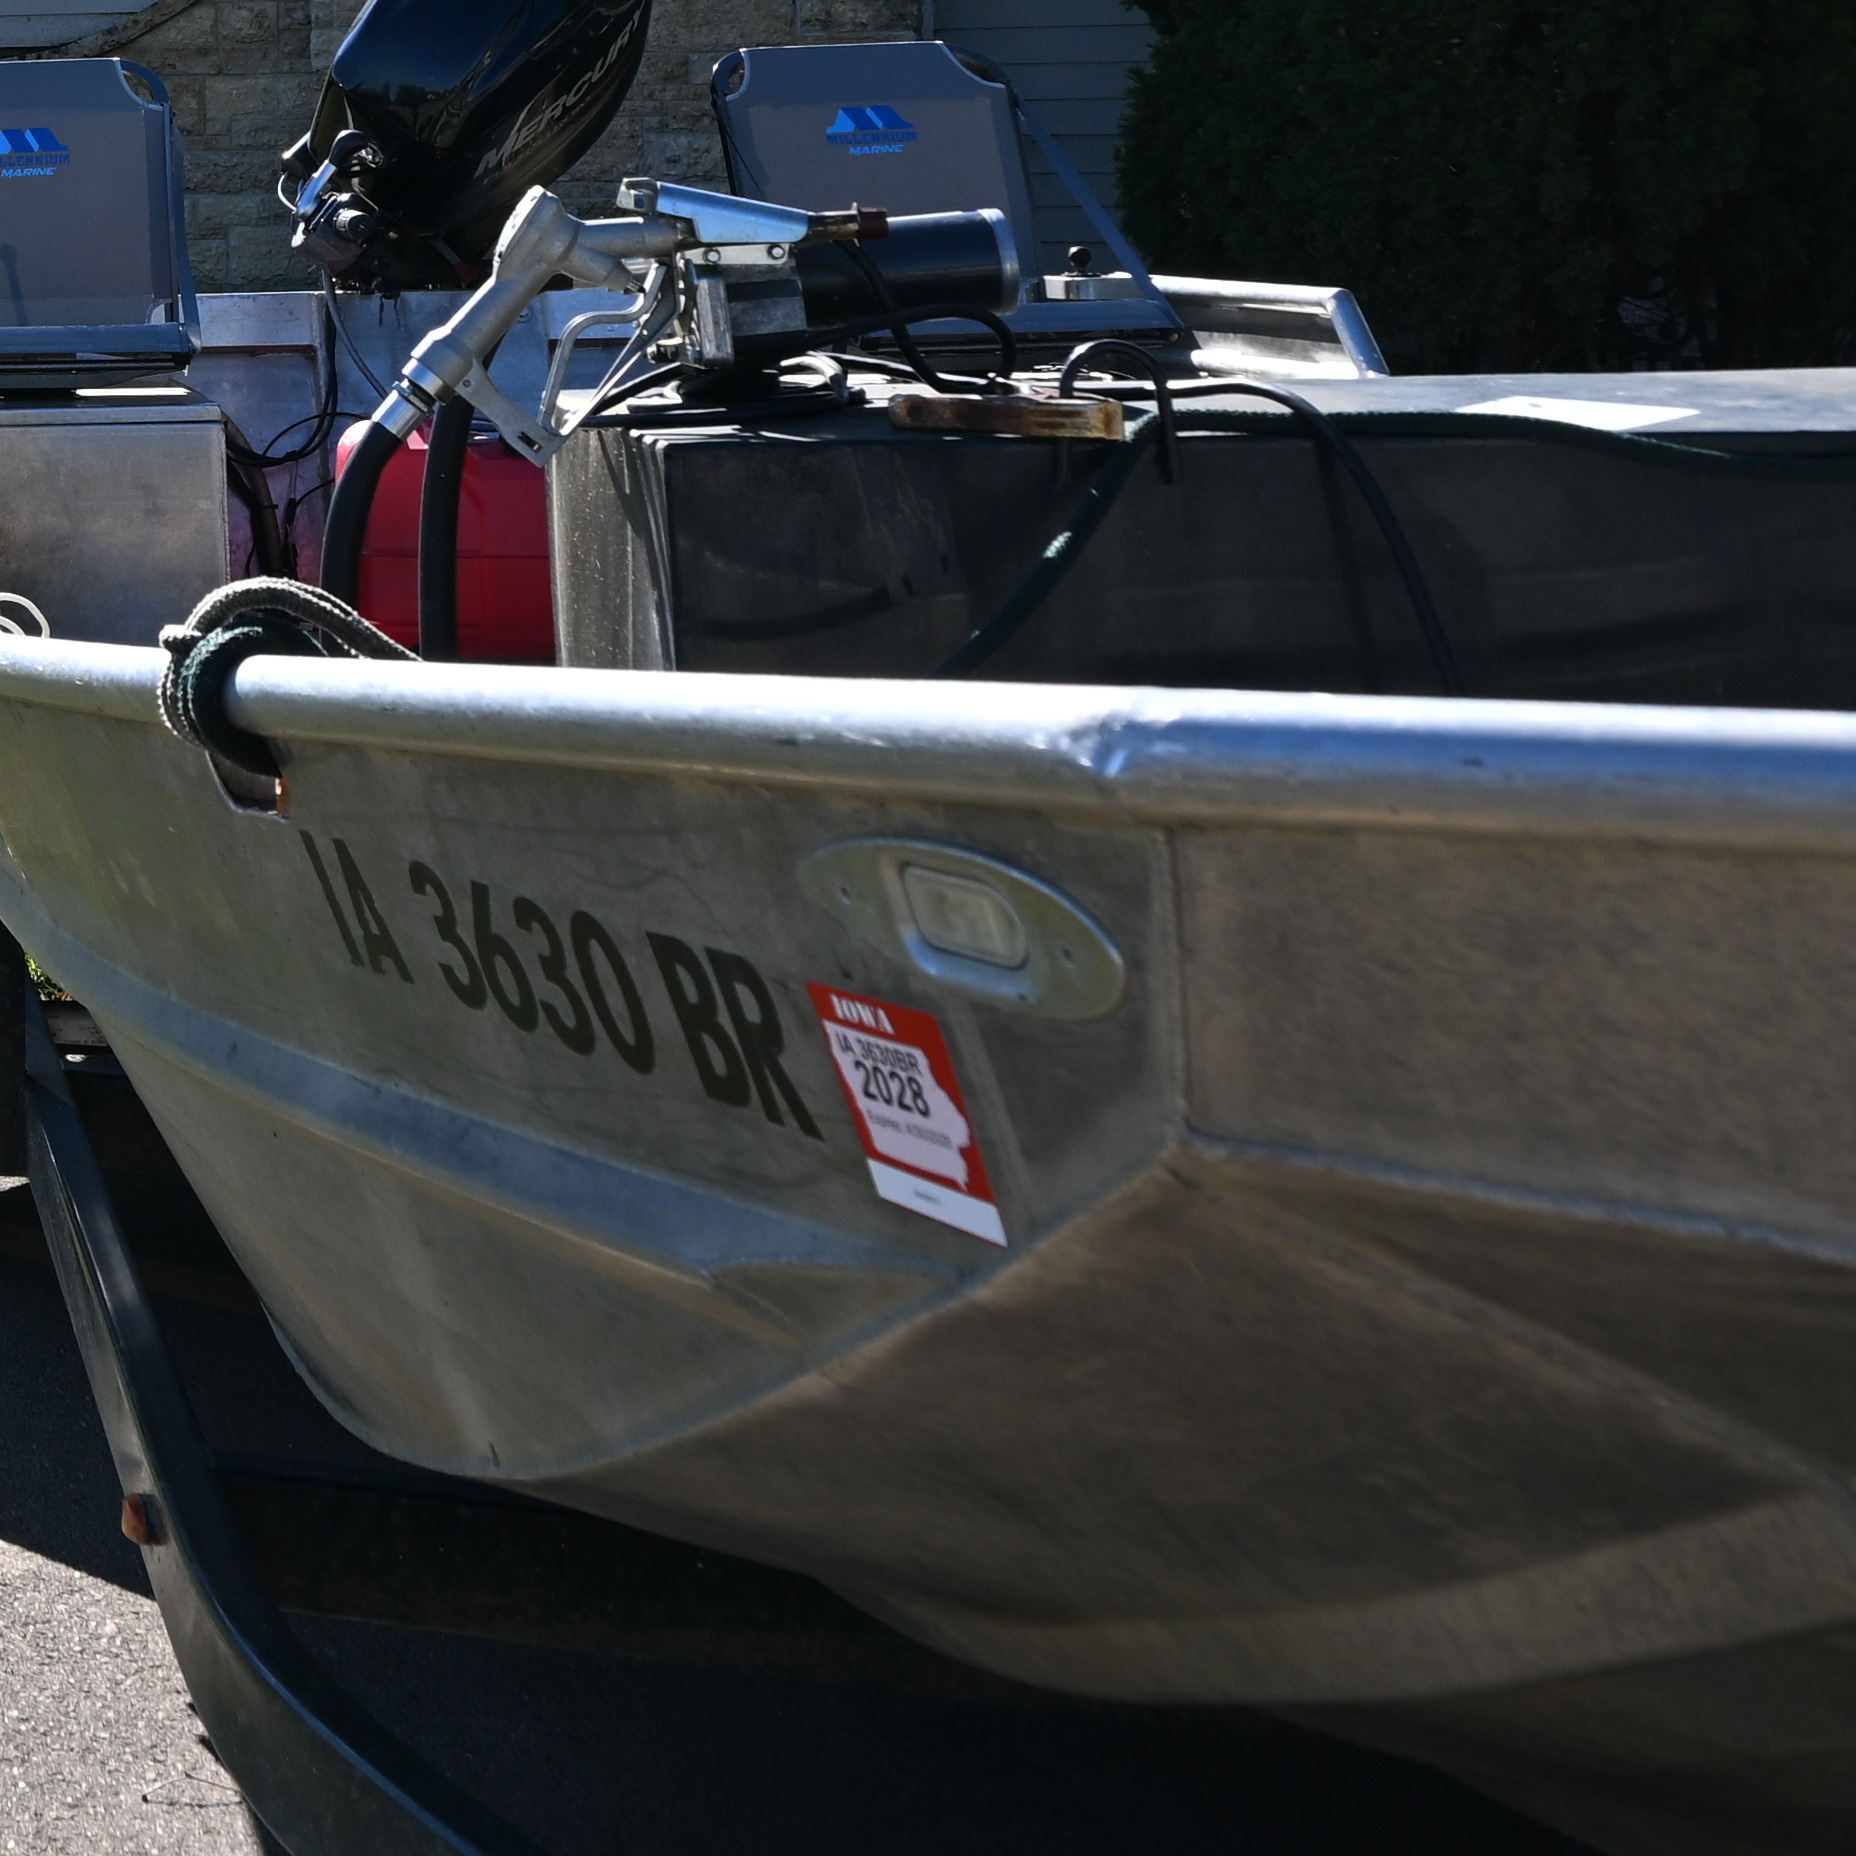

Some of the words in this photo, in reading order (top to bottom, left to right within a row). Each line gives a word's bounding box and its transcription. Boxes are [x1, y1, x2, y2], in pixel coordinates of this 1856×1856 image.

[848, 144, 905, 156] MARINE
[1, 167, 56, 178] MARINE
[299, 829, 414, 984] IA
[408, 860, 655, 1075] 3630
[644, 931, 825, 1142] BR
[830, 993, 896, 1035] IOWA
[835, 1032, 856, 1055] IA
[854, 1059, 931, 1119] 2028
